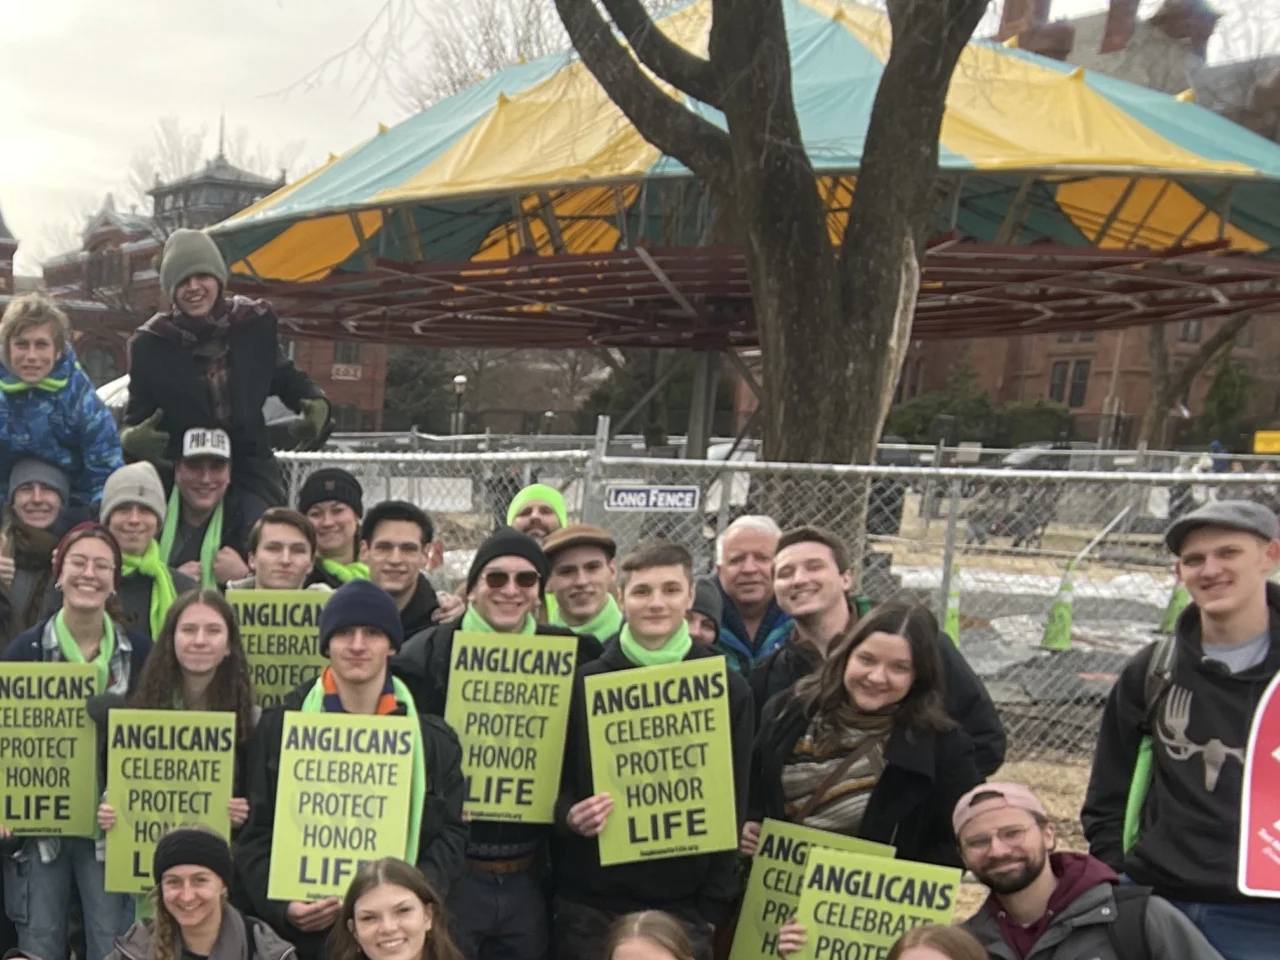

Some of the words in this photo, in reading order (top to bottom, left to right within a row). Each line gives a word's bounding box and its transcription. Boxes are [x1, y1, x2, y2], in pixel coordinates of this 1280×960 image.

[609, 488, 647, 507] LONG
[649, 488, 694, 507] FENCE
[454, 645, 573, 677] ANGLICANS
[461, 679, 560, 707] CELEBRATE
[591, 671, 725, 717] ANGLICANS
[111, 724, 233, 752] ANGLICANS
[465, 712, 549, 739] PROTECT
[604, 708, 715, 745] CELEBRATE
[0, 737, 78, 759] PROTECT
[285, 725, 412, 755] ANGLICANS
[121, 757, 221, 782] CELEBRATE
[468, 743, 537, 771] HONOR
[616, 742, 709, 777] PROTECT
[6, 766, 70, 788] HONOR
[293, 759, 398, 786] CELEBRATE
[128, 789, 213, 814] PROTECT
[464, 775, 534, 806] LIFE
[626, 776, 704, 808] HONOR
[5, 795, 71, 821] LIFE
[298, 791, 388, 819] PROTECT
[303, 824, 377, 851] HONOR
[627, 807, 708, 844] LIFE
[807, 863, 954, 911] ANGLICANS
[813, 900, 934, 938] CELEBRAT
